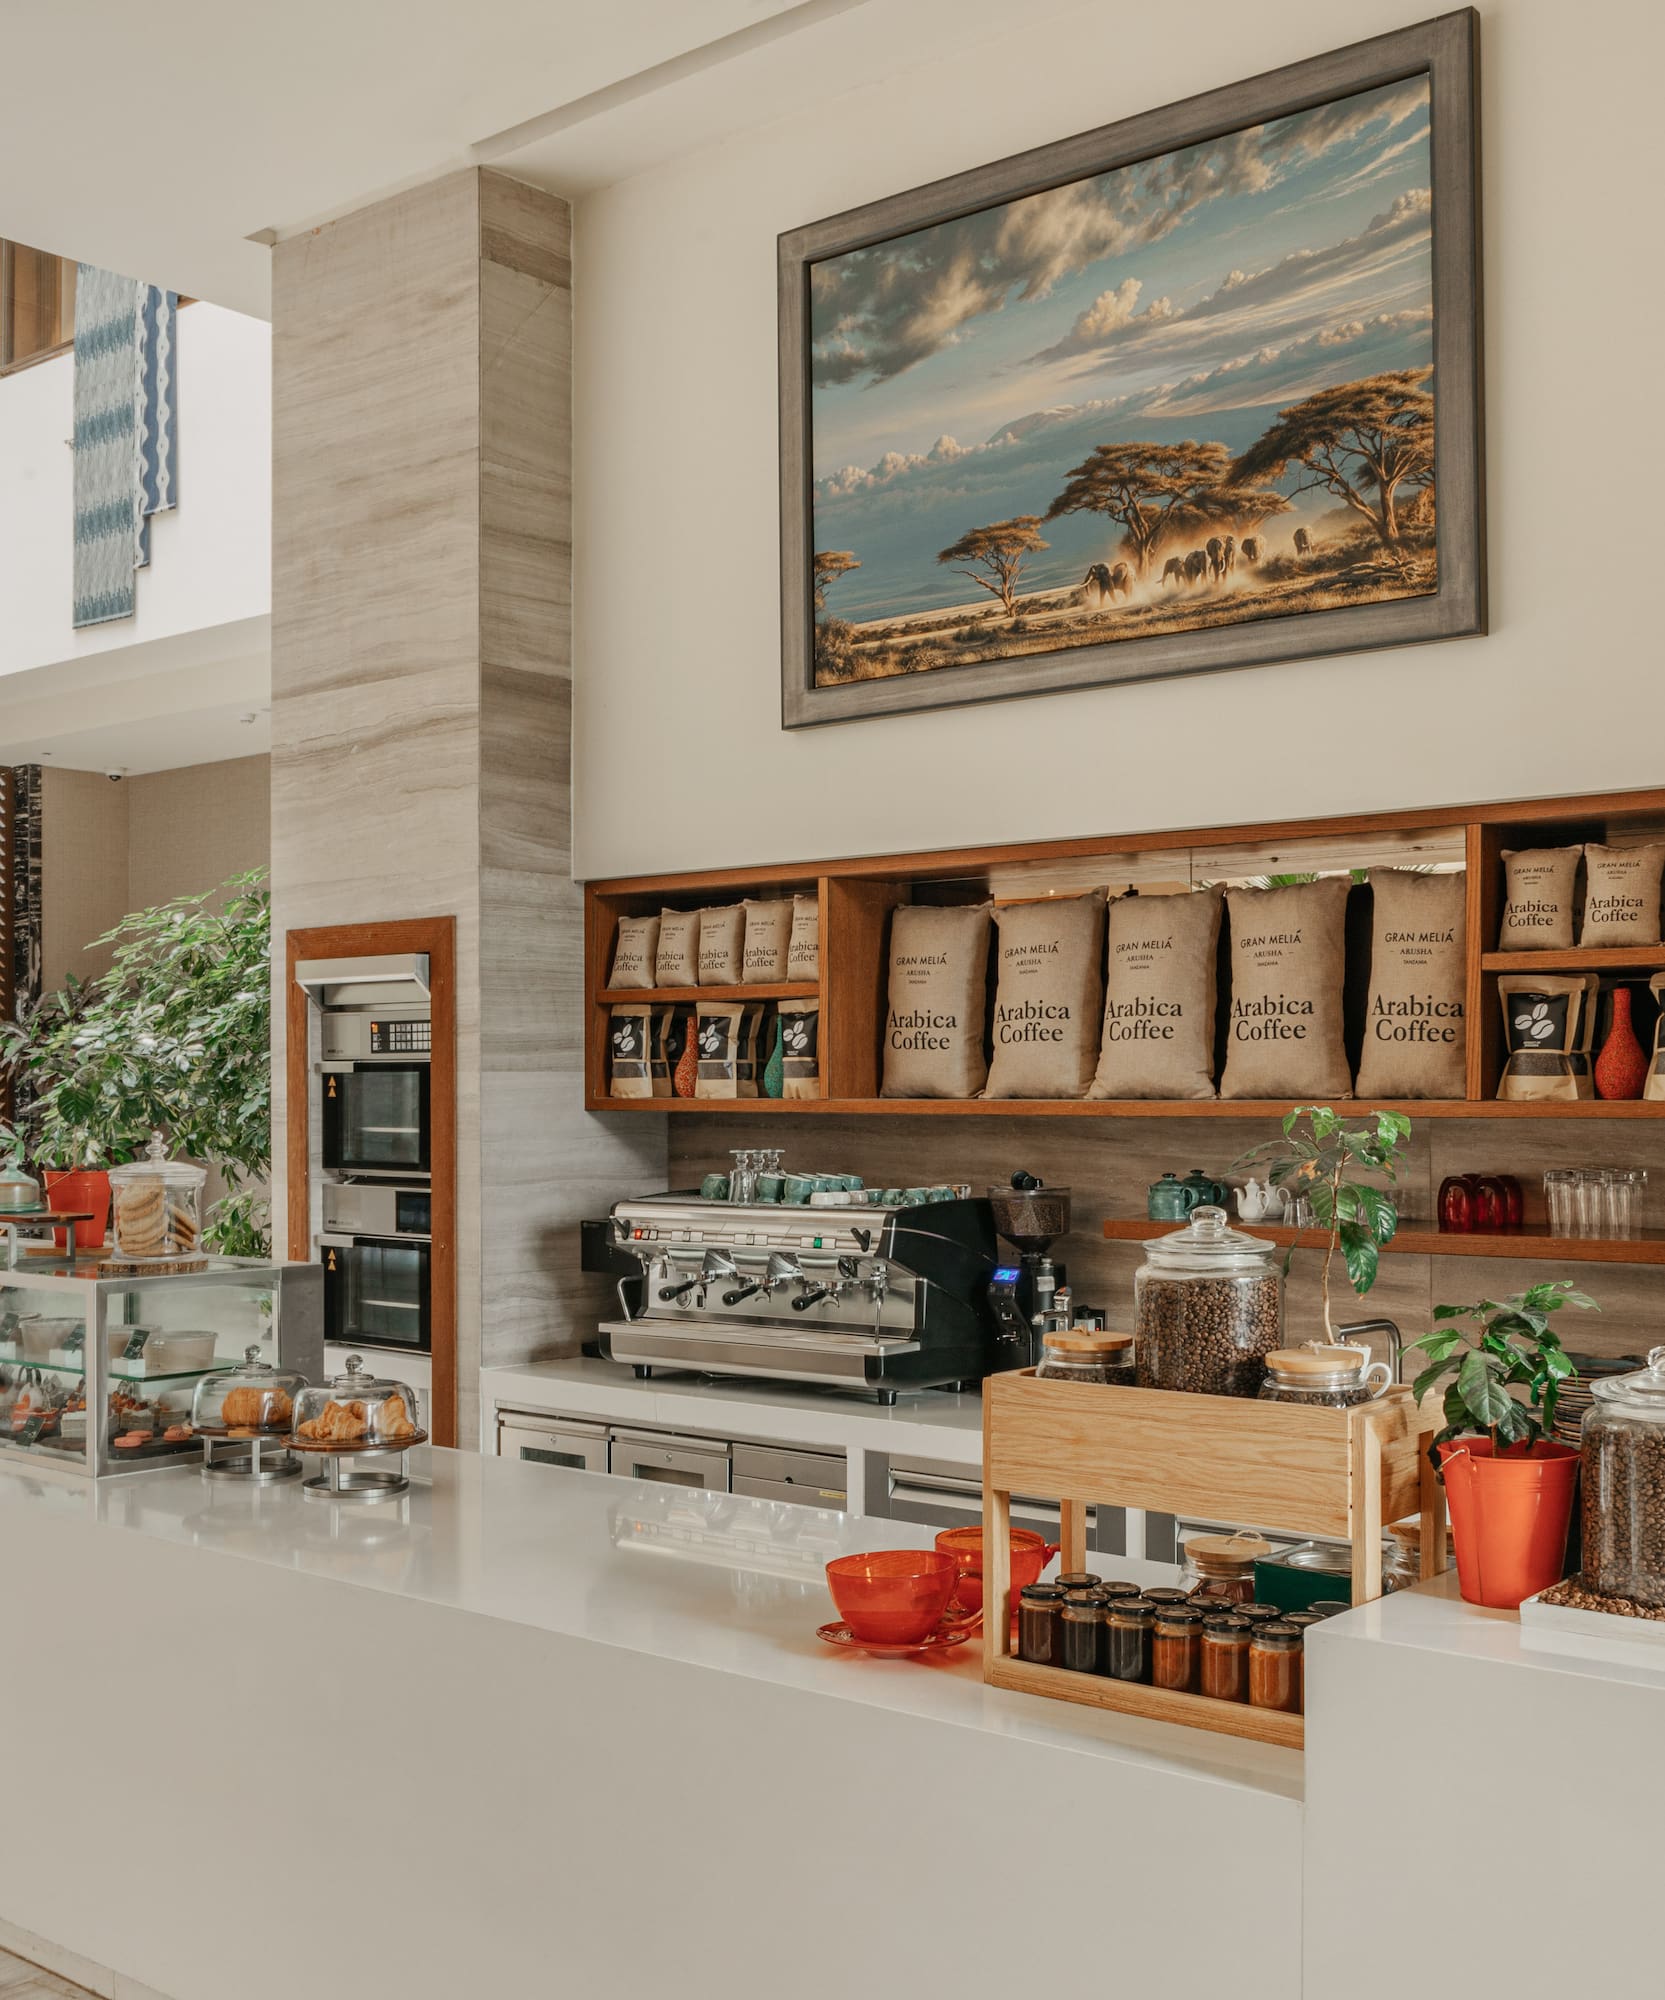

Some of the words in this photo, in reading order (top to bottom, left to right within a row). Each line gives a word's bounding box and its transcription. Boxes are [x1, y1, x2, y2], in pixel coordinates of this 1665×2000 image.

[1513, 867, 1532, 875] GRAN
[1618, 859, 1641, 868] MELIÁ
[1506, 900, 1558, 915] Arabica
[1589, 895, 1644, 909] Arabica
[1508, 913, 1553, 927] Coffee
[1591, 908, 1638, 923] Coffee
[1240, 936, 1266, 949] GRAN
[1268, 929, 1302, 944] MELIÁ
[1385, 932, 1415, 943] GRAN
[1418, 928, 1455, 943] MELIÁ
[1004, 946, 1027, 958] GRAN
[1029, 940, 1059, 954] MELIÁ
[1116, 941, 1139, 954] GRAN
[1142, 936, 1173, 950] MELIÁ
[896, 956, 917, 966] GRAN
[919, 952, 947, 965] MELIÁ
[1126, 954, 1154, 962] ARUSHA
[1253, 949, 1283, 958] ARUSHA
[746, 957, 775, 968] Coffee
[1015, 958, 1041, 967] ARUSHA
[906, 969, 931, 977] ARUSHA
[996, 1000, 1070, 1023] Arabica
[1106, 996, 1183, 1020] Arabica
[1232, 994, 1314, 1019] Arabica
[1371, 994, 1464, 1018] Arabica
[889, 1009, 957, 1029] Arabica
[1000, 1022, 1063, 1044] Coffee
[1109, 1019, 1174, 1041] Coffee
[1235, 1018, 1307, 1041] Coffee
[1375, 1018, 1456, 1042] Coffee
[891, 1030, 950, 1050] Coffee
